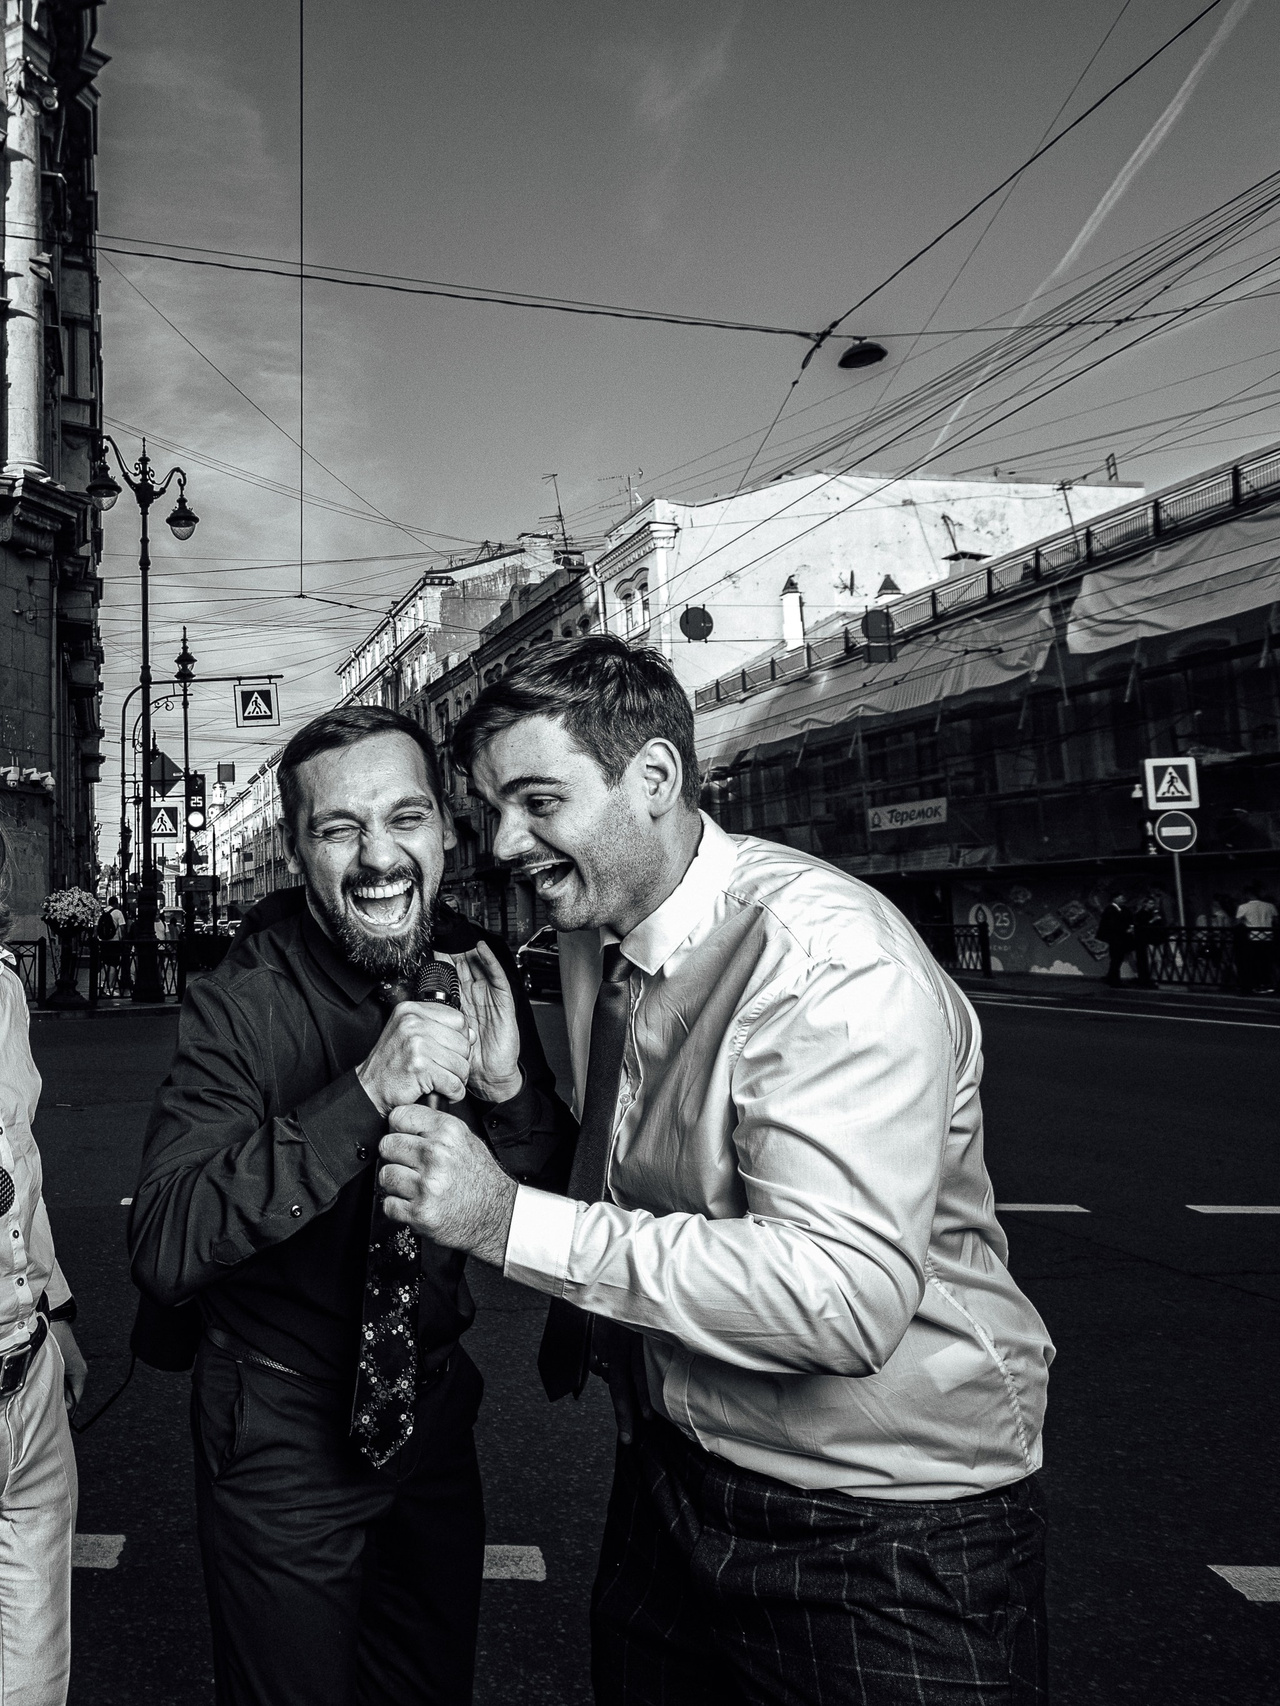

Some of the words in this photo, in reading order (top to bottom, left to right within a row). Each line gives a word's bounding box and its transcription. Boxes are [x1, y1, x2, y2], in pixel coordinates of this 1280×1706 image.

[190, 796, 203, 807] 25
[887, 805, 941, 825] Теремок
[995, 912, 1010, 927] 25
